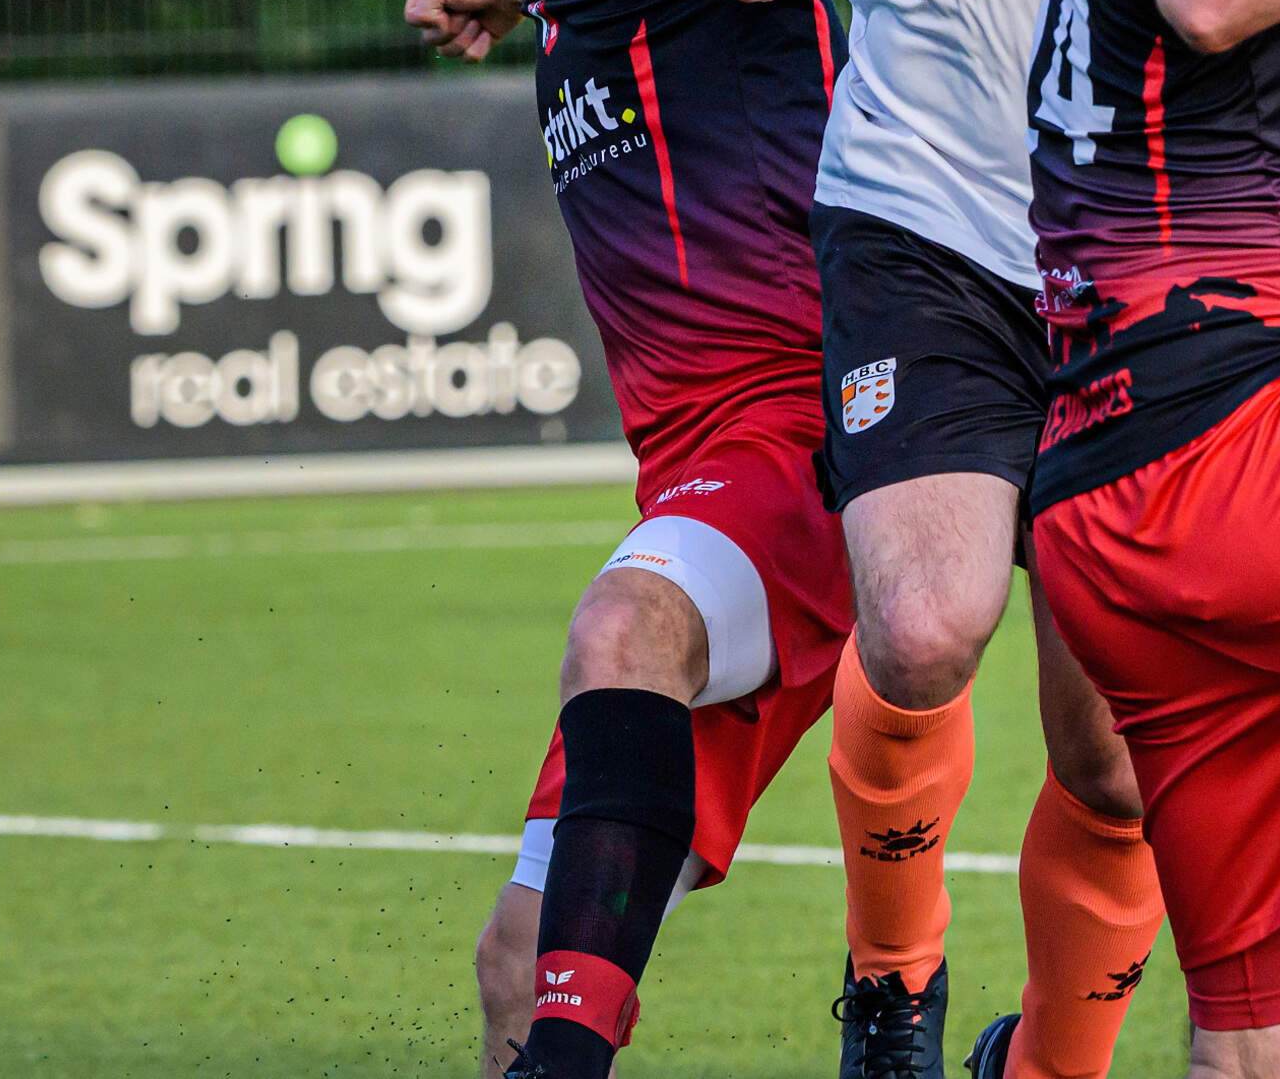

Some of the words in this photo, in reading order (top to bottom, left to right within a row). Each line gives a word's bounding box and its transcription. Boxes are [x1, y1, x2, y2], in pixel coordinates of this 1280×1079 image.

[37, 113, 493, 336] Spring
[129, 328, 300, 428] real
[310, 322, 582, 421] estate
[845, 362, 893, 386] H.B.C.
